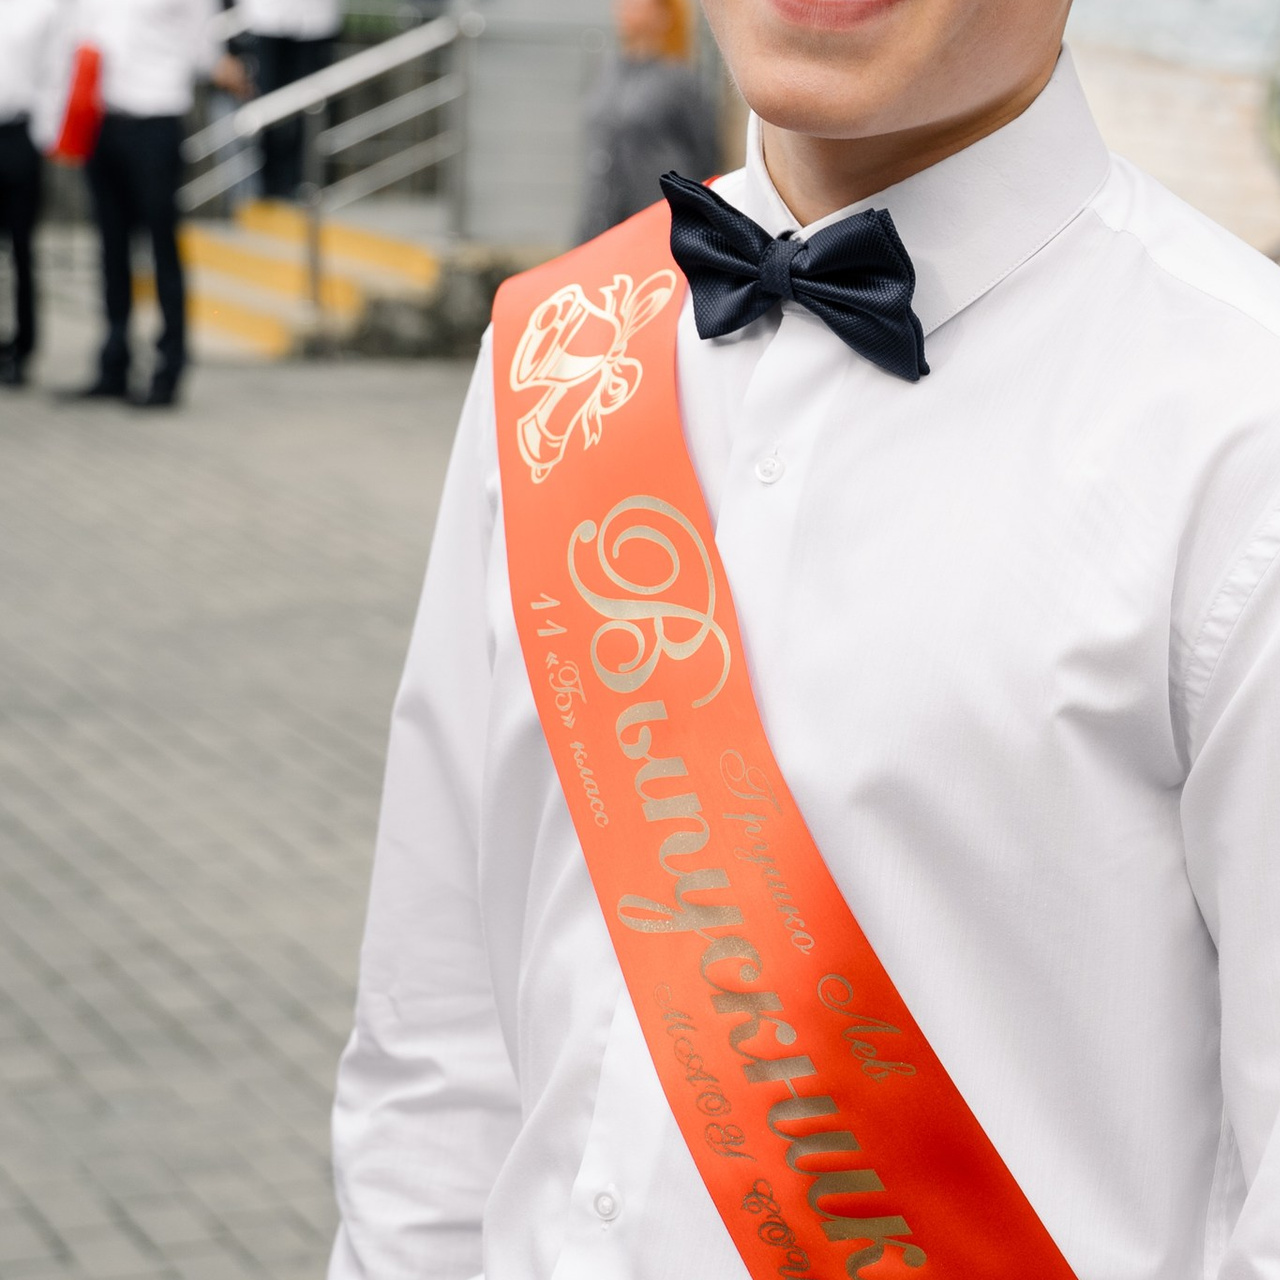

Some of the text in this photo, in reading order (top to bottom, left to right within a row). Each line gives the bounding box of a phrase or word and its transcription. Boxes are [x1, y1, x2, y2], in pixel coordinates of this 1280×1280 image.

[530, 592, 609, 828] 11 «Б» класс
[816, 973, 917, 1083] Лев
